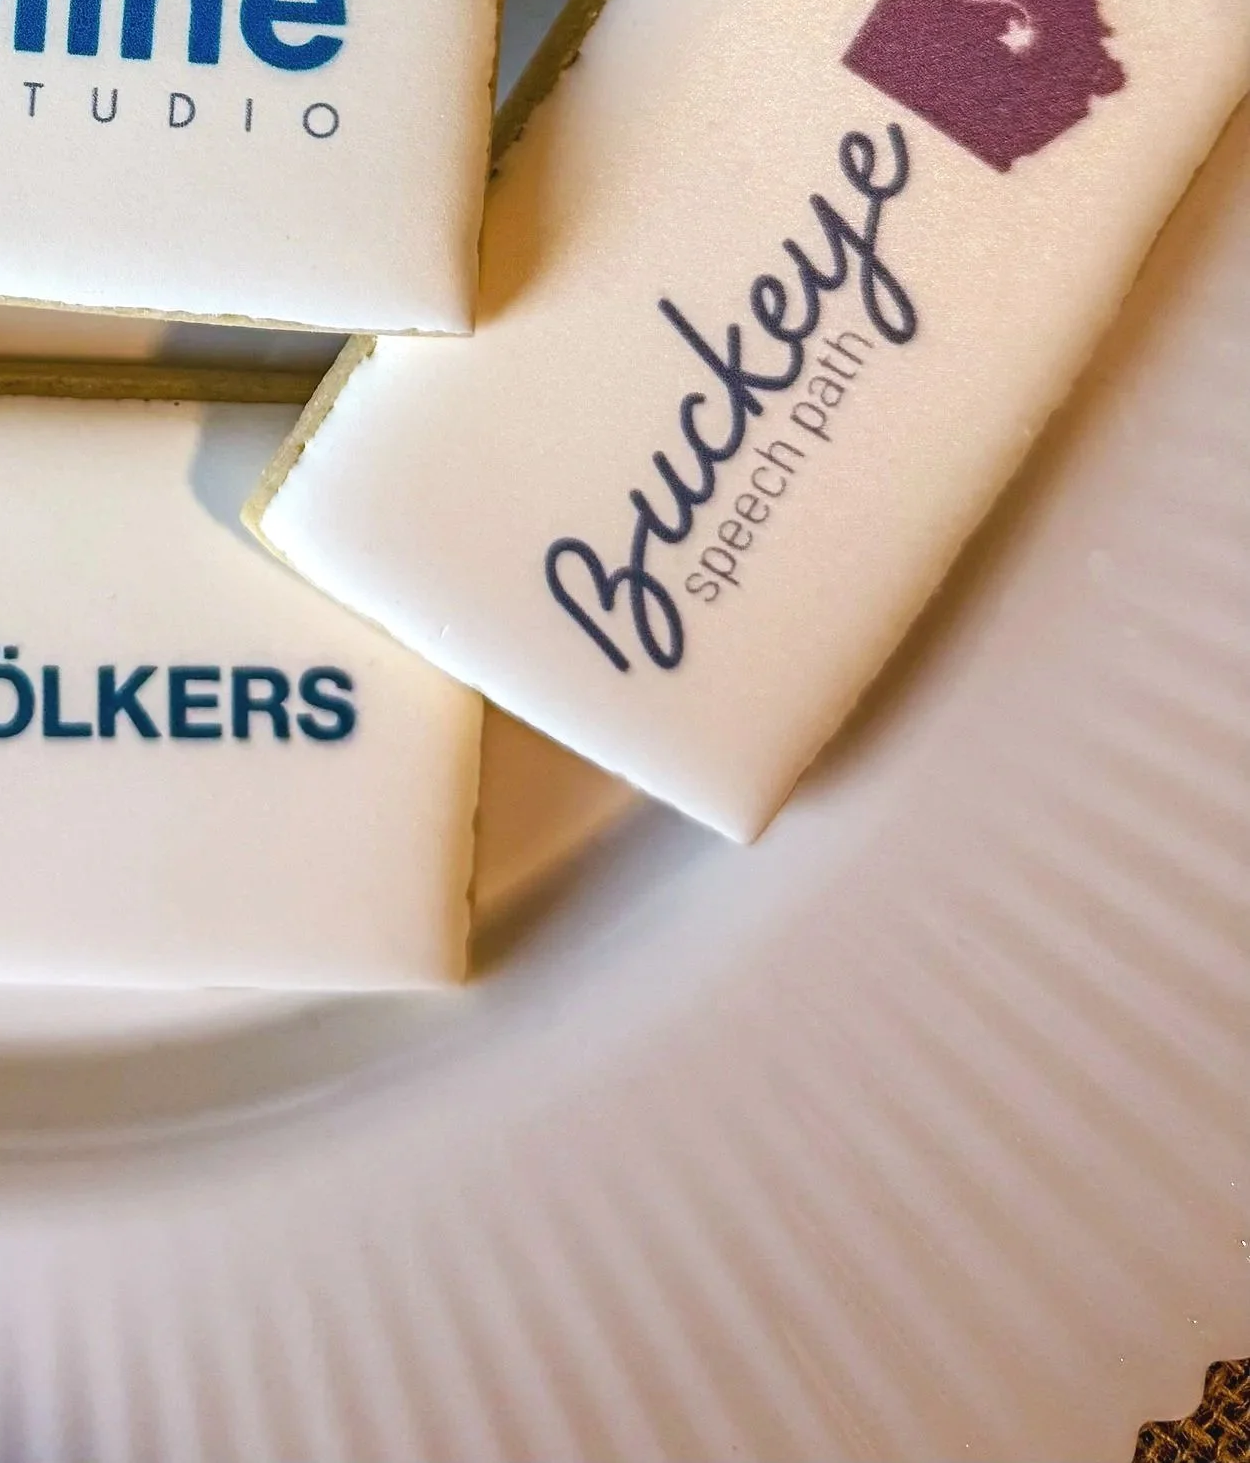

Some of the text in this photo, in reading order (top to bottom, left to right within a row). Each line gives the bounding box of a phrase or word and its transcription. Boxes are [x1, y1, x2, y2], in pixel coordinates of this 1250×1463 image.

[545, 122, 918, 673] Buckeye
[684, 328, 875, 606] speech path
